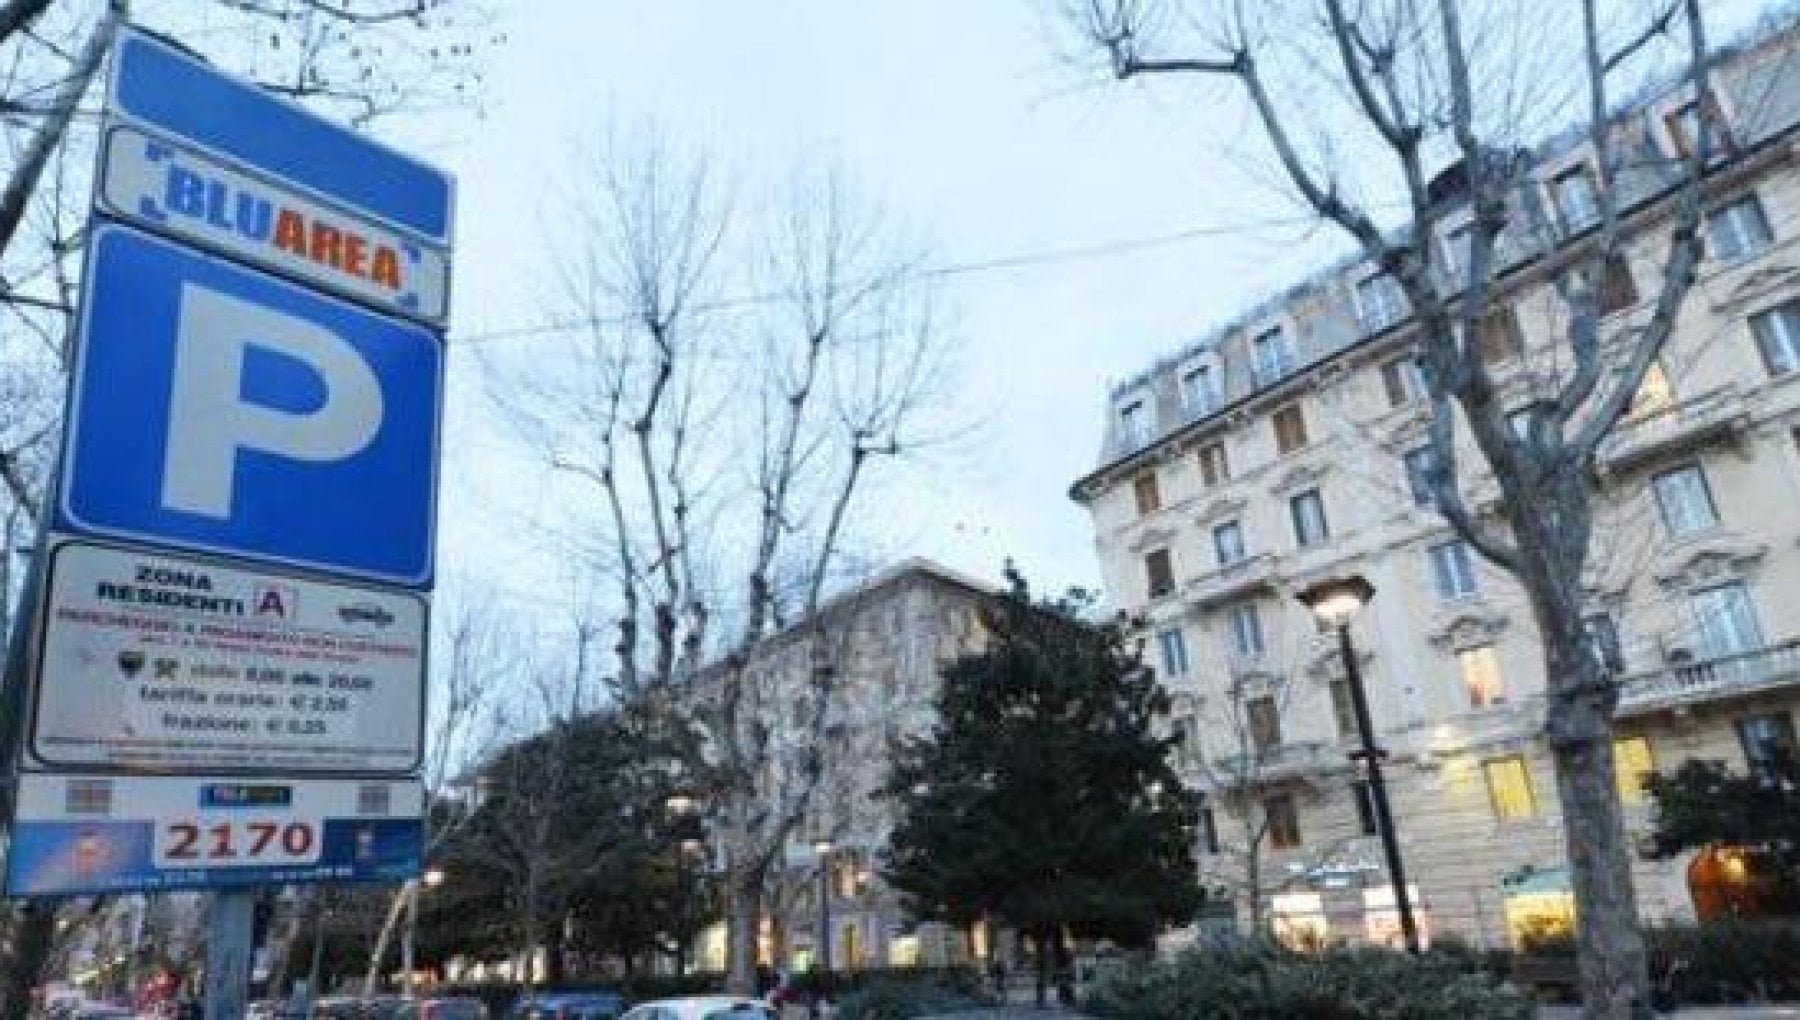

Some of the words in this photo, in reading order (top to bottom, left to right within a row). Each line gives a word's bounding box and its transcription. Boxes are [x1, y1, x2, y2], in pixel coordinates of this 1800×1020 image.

[165, 165, 402, 291] BLUAREA
[161, 281, 384, 520] P
[135, 564, 213, 592] ZONA
[97, 581, 246, 616] RESIDENTI
[258, 588, 284, 618] A
[165, 821, 313, 861] 2170
